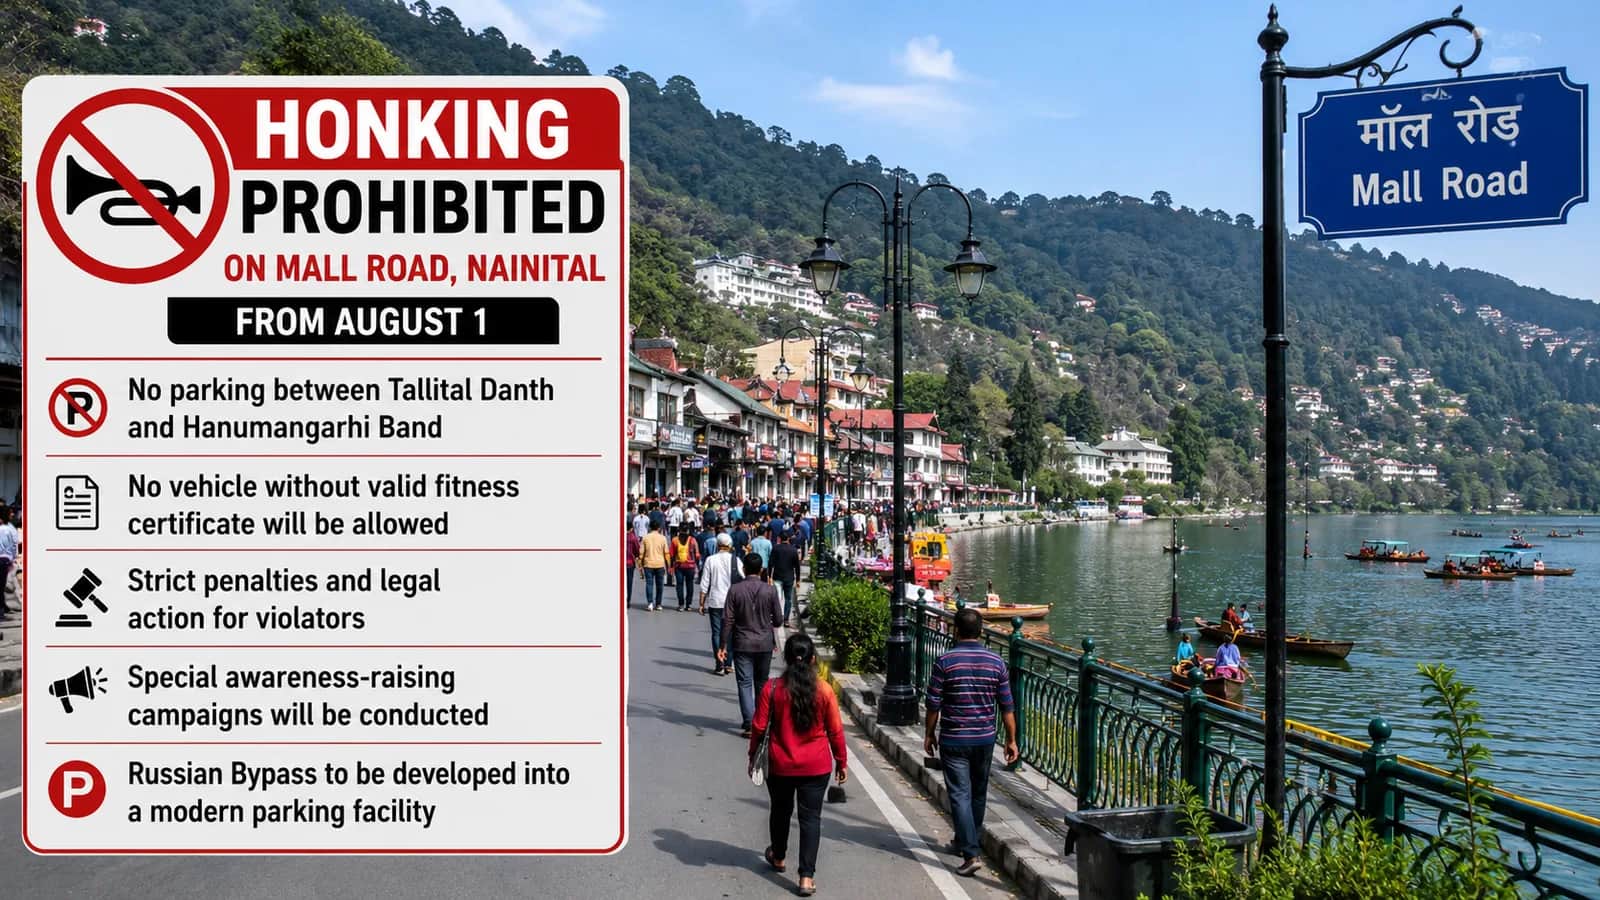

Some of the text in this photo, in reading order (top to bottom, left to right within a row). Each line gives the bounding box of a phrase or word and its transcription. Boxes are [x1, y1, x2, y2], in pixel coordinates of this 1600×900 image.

[1356, 95, 1523, 152] मॉल रोड़
[1352, 160, 1528, 207] Mall Road
